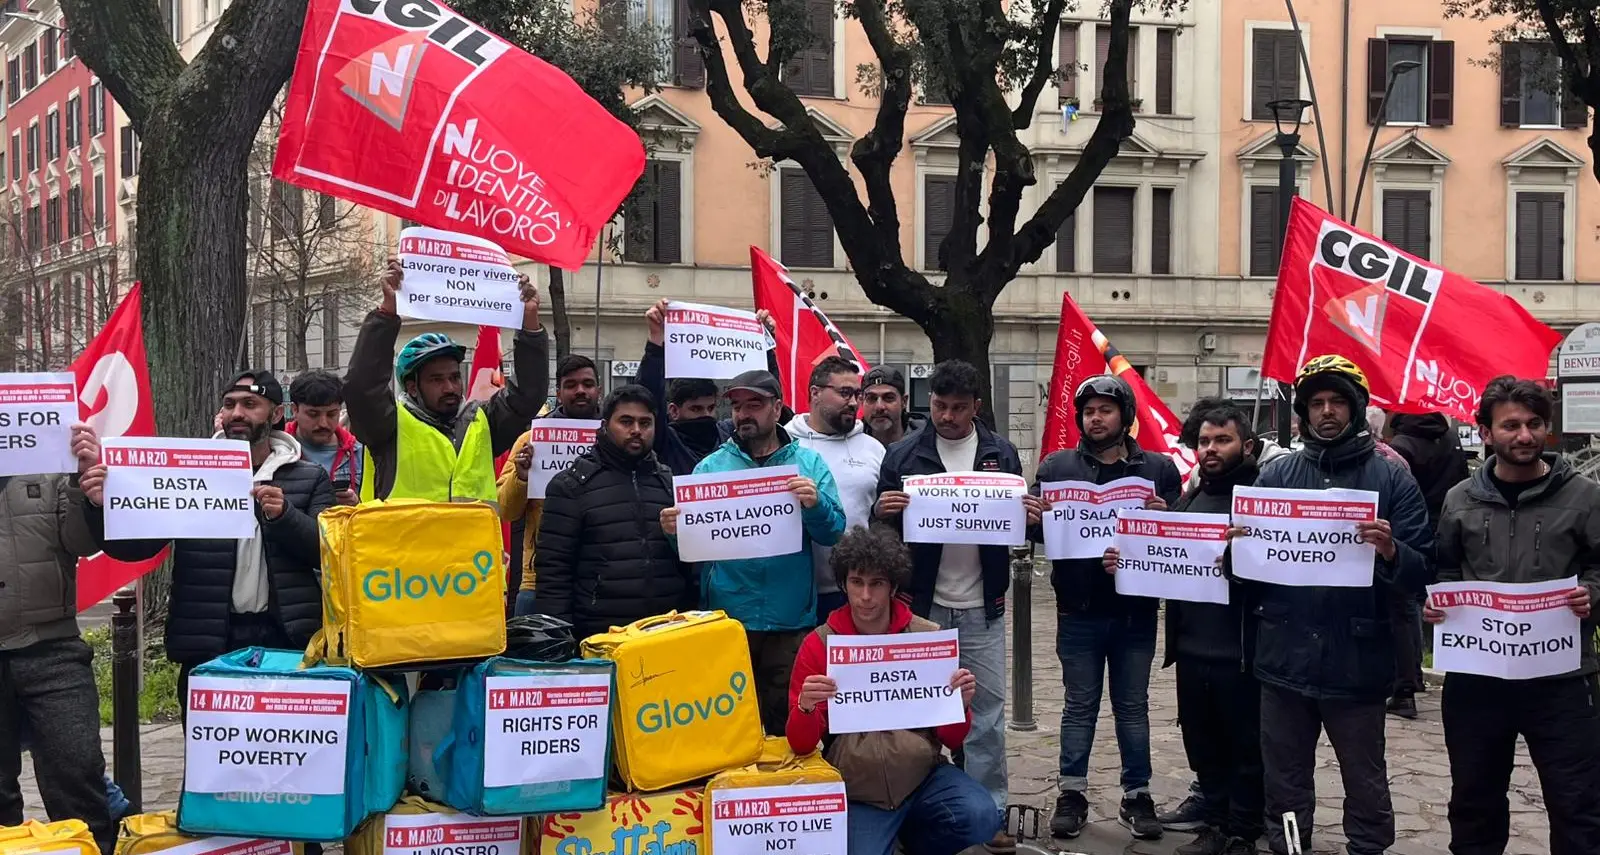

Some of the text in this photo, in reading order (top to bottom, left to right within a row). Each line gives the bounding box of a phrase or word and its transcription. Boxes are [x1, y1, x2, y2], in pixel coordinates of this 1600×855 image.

[442, 118, 546, 194] NUOVE
[445, 191, 556, 246] LAVORO
[402, 239, 413, 252] 14
[418, 239, 452, 257] MARZO
[400, 259, 518, 281] Lavorare per vivere
[1320, 229, 1433, 304] CGIL
[447, 280, 476, 291] NON
[409, 293, 513, 311] per sopravvivere
[669, 312, 679, 323] 14
[683, 311, 710, 325] MARZO
[670, 333, 763, 351] STOP WORKING
[690, 349, 747, 362] POVERTY
[1563, 357, 1600, 369] BENVE
[1056, 329, 1082, 450] ww.filcams.cgil.it
[1416, 359, 1482, 406] NUOV
[18, 411, 60, 427] FOR
[534, 430, 544, 441] 14
[548, 430, 578, 442] MARZO
[109, 450, 167, 466] 14 MARZO
[552, 445, 563, 455] IL
[153, 477, 208, 491] BASTA
[678, 488, 690, 501] 14
[695, 484, 728, 500] MARZO
[918, 488, 1013, 500] WORK TO LIVE
[1045, 492, 1055, 501] 14
[1060, 490, 1090, 501] MARZO
[110, 497, 249, 511] PAGHE DA FAME
[951, 503, 979, 513] NOT
[1237, 499, 1248, 513] 14
[1254, 501, 1291, 516] MARZO
[685, 503, 794, 525] BASTA LAVORO
[1054, 505, 1075, 521] PIÙ
[711, 524, 771, 540] POVERO
[918, 518, 1012, 531] JUST SURVIVE
[1128, 521, 1158, 535] MARZO
[1147, 545, 1188, 559] BASTA
[1267, 548, 1336, 563] POVERO
[1116, 558, 1222, 577] SFRUTTAMENTO
[363, 566, 477, 602] Glovo
[1435, 594, 1449, 606] 14
[1454, 592, 1493, 607] MARZO
[1482, 618, 1532, 636] STOP
[1441, 633, 1574, 657] EXPLOITATION
[832, 649, 844, 663] 14
[849, 648, 883, 663] MARZO
[870, 670, 917, 683] BASTA
[193, 692, 255, 710] 14 MARZO
[492, 693, 504, 707] 14
[510, 691, 542, 706] MARZO
[834, 685, 954, 704] SFRUTTAMENTO
[636, 693, 734, 733] Glovo
[503, 715, 598, 733] RIGHTS FOR
[192, 726, 339, 744] STOP WORKING
[521, 738, 580, 756] RIDERS
[219, 750, 308, 766] POVERTY
[717, 801, 770, 817] 14 MARZO
[729, 818, 832, 836] WORK TO LIVE
[390, 831, 402, 845] 14
[408, 827, 444, 845] MARZO
[766, 839, 797, 851] NOT
